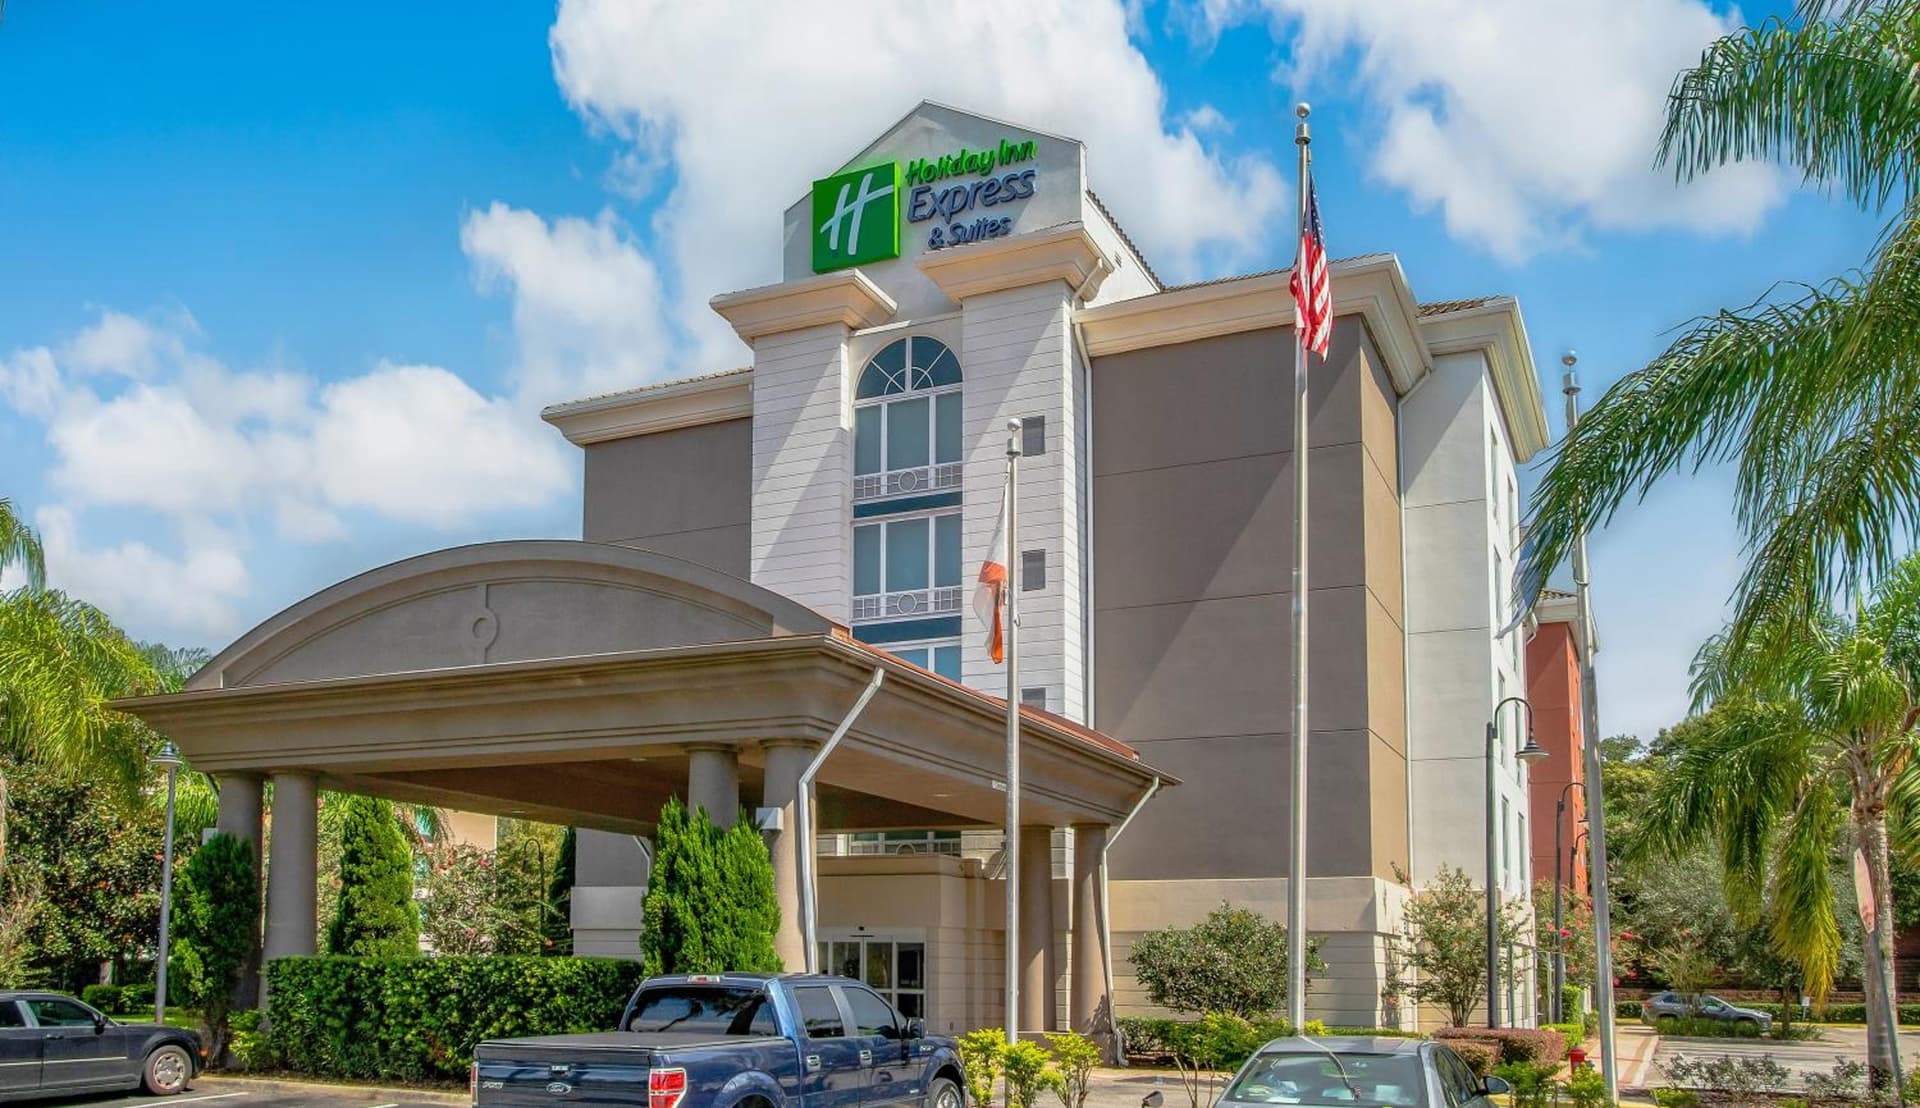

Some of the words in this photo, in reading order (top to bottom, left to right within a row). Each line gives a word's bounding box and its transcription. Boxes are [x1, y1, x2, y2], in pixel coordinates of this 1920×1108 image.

[905, 148, 995, 187] Holiday
[998, 138, 1036, 167] Inn
[907, 169, 1036, 224] Express
[928, 227, 945, 250] &
[946, 216, 1011, 246] Suites
